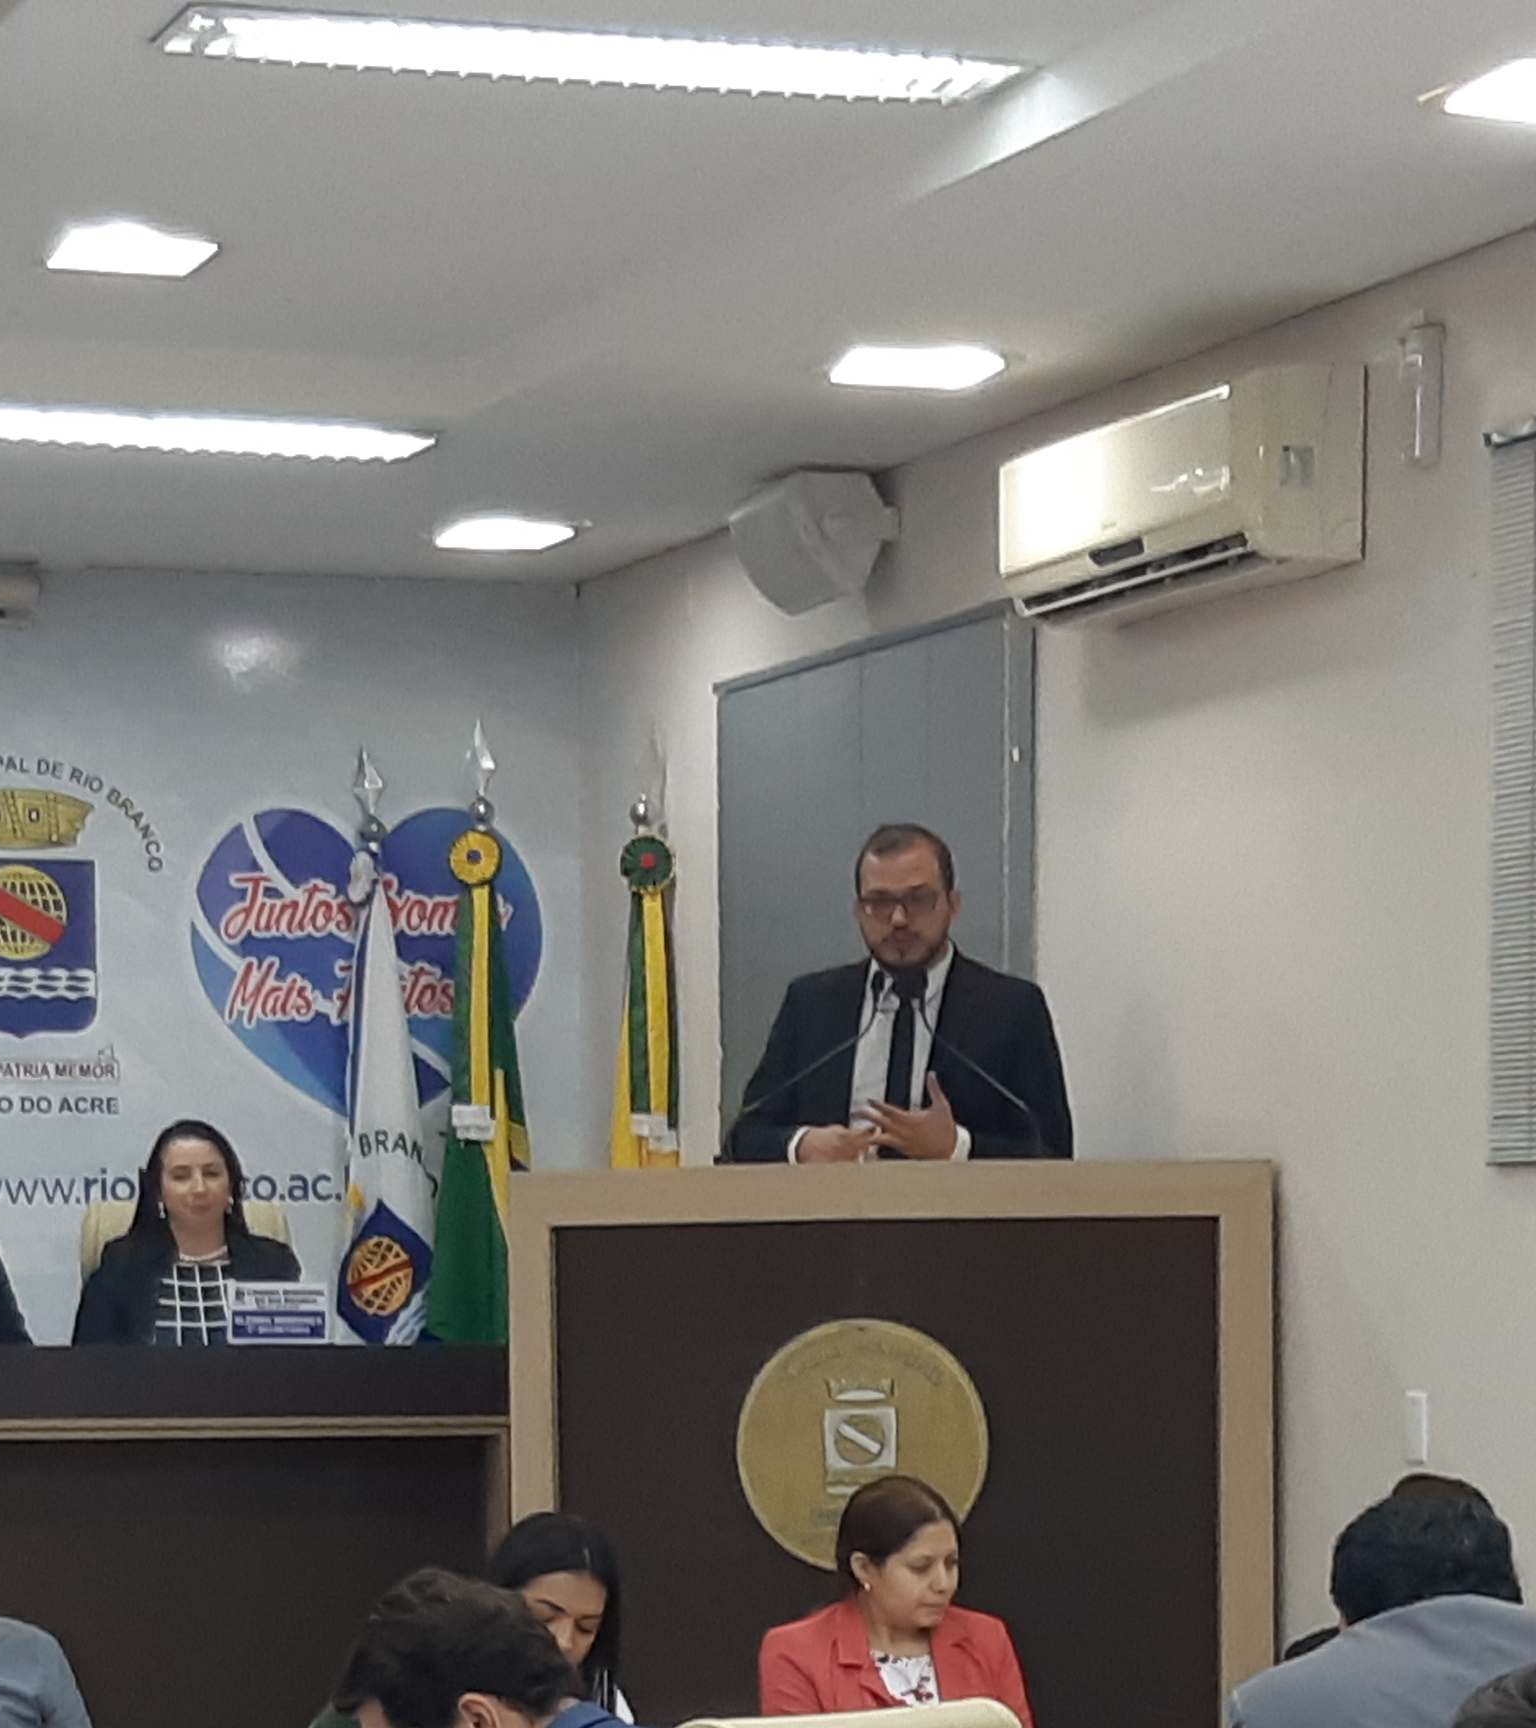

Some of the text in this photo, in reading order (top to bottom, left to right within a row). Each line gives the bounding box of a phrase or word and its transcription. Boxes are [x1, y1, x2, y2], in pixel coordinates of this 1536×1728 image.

[36, 758, 63, 779] DE
[68, 766, 104, 793] RIO
[105, 788, 163, 872] BRANCO
[221, 874, 356, 942] Juntos
[227, 958, 315, 1027] Mais
[19, 1095, 53, 1115] DO
[58, 1095, 120, 1115] ACRE
